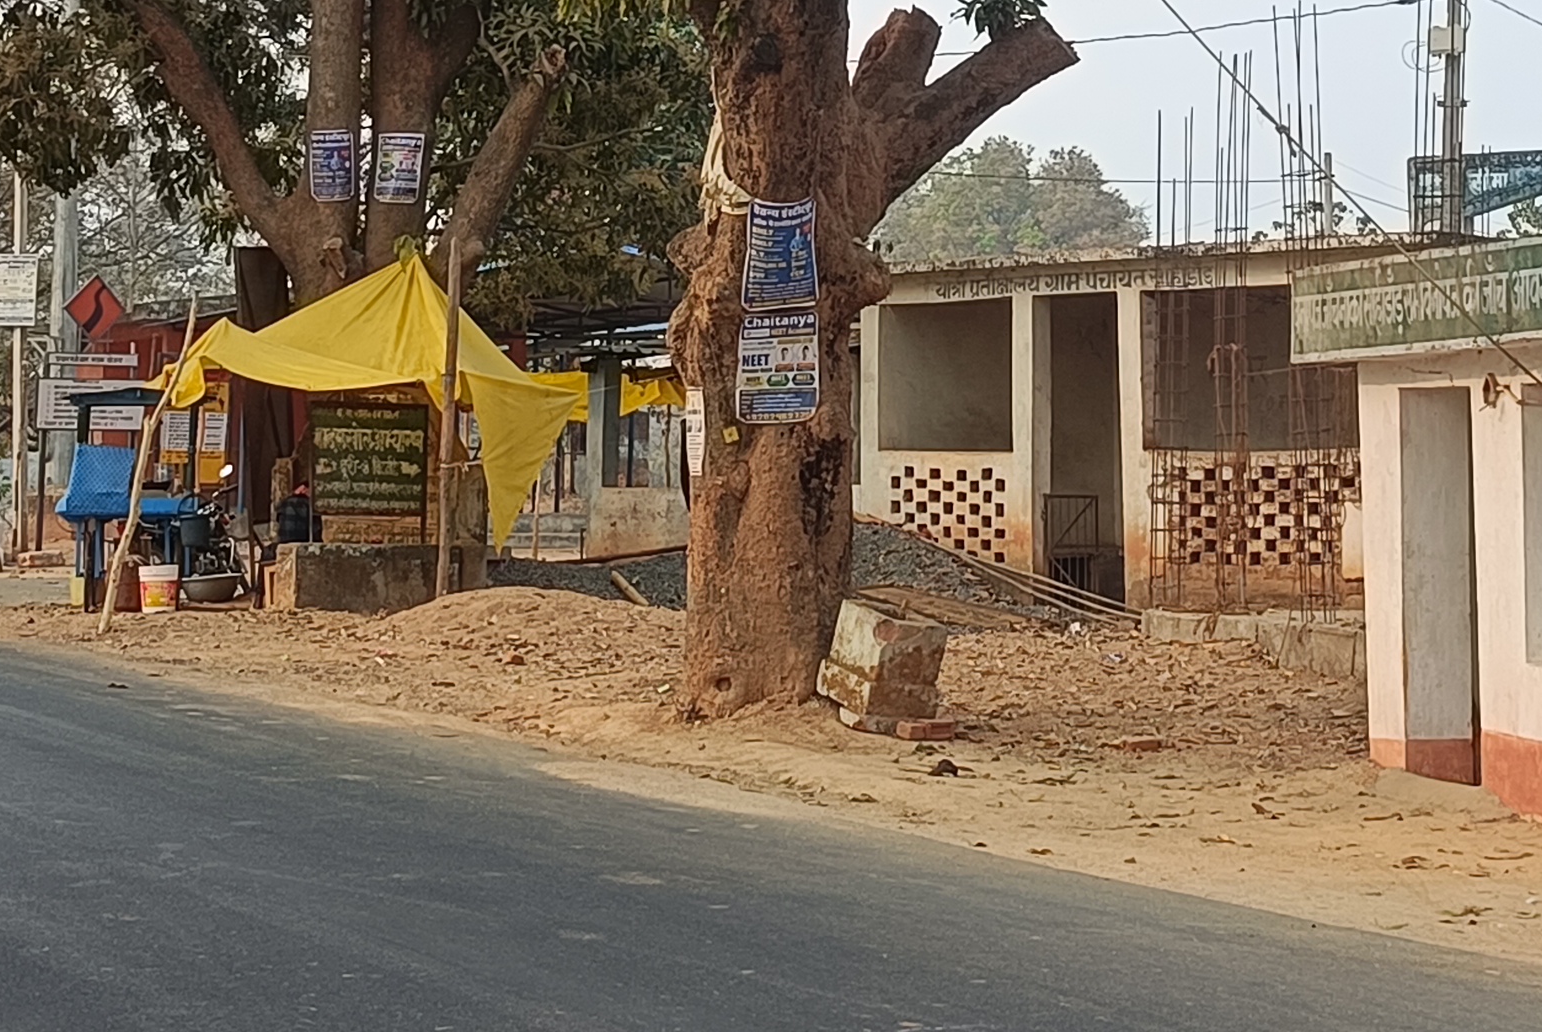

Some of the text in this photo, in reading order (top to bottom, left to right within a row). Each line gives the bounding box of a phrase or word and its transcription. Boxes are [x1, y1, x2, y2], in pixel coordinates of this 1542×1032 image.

[1044, 271, 1080, 292] ग्राम
[1085, 266, 1146, 290] पंचायत
[744, 314, 815, 329] Chaitanya
[741, 353, 771, 368] NEET
